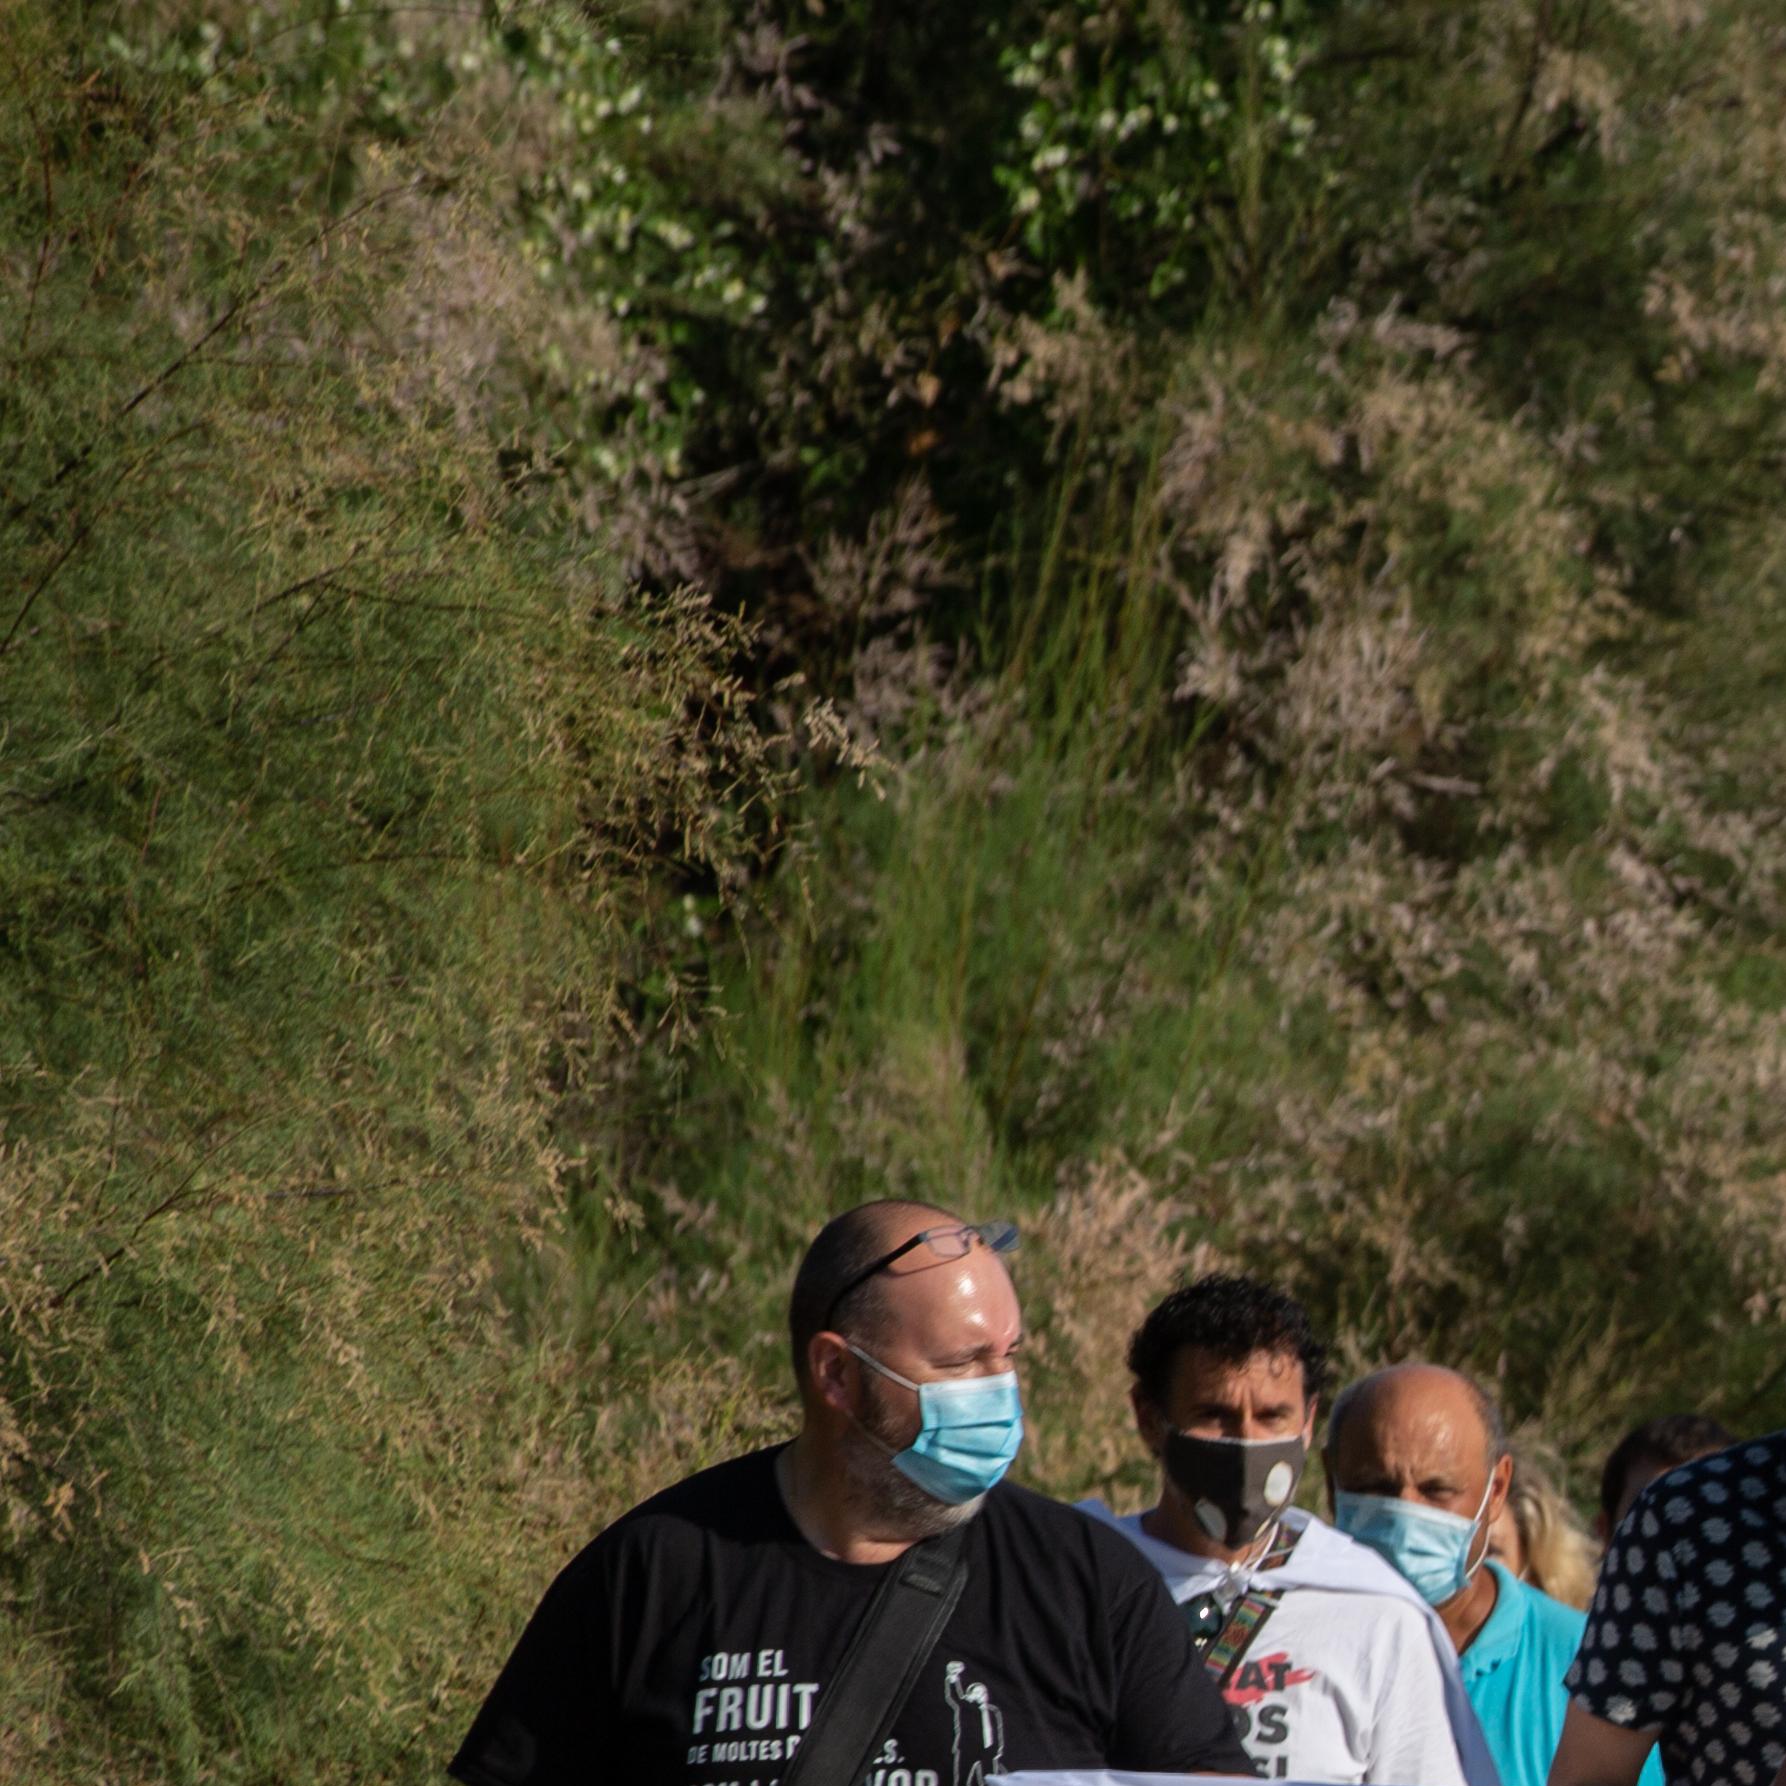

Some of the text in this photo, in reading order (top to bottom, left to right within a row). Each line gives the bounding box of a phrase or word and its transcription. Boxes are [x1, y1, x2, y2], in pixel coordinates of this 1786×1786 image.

[700, 1649, 789, 1682] SOM EL
[692, 1683, 820, 1735] FRUIT
[687, 1744, 708, 1765] DE
[711, 1738, 783, 1763] MOLTES
